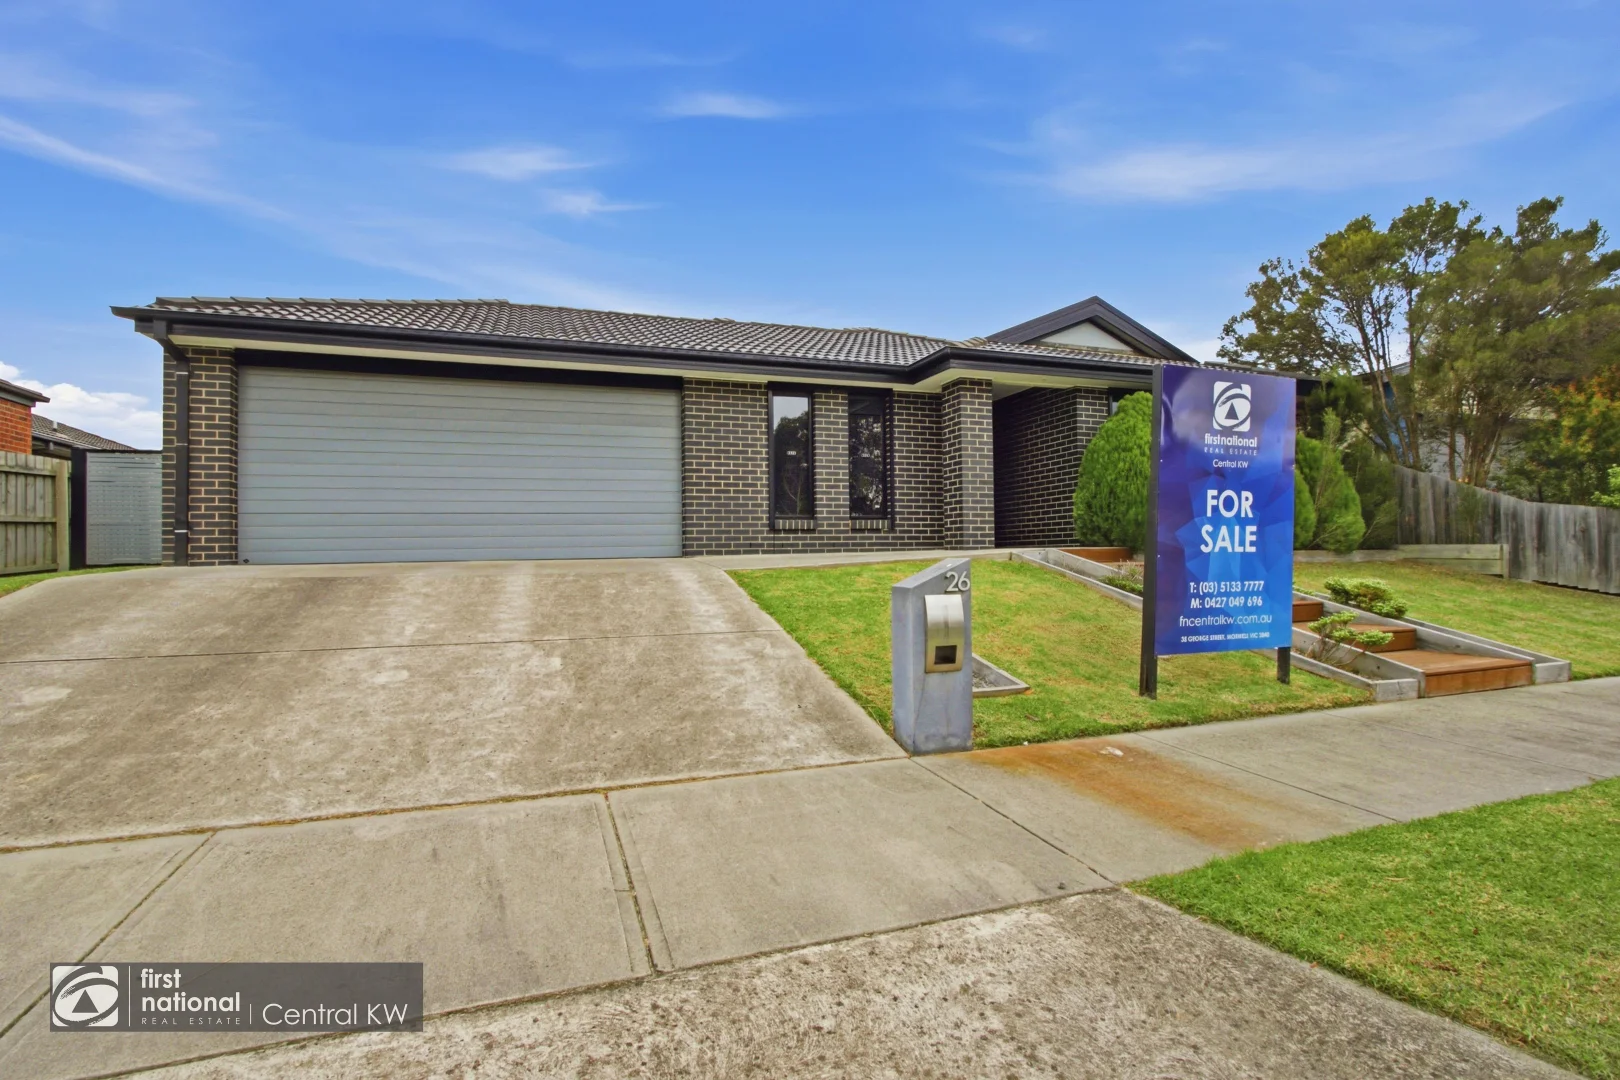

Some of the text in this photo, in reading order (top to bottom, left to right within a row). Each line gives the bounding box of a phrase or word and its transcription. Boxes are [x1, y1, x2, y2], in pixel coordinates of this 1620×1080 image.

[1229, 448, 1258, 456] ESTATE
[1212, 459, 1249, 469] Central KW
[1206, 489, 1254, 518] FOR
[1200, 524, 1257, 553] SALE
[945, 571, 971, 592] 26
[1189, 580, 1265, 596] T: (03) 5133 7777
[1190, 595, 1263, 609] M: 0427 049 696
[1179, 614, 1272, 627] fncentralkw.com.au
